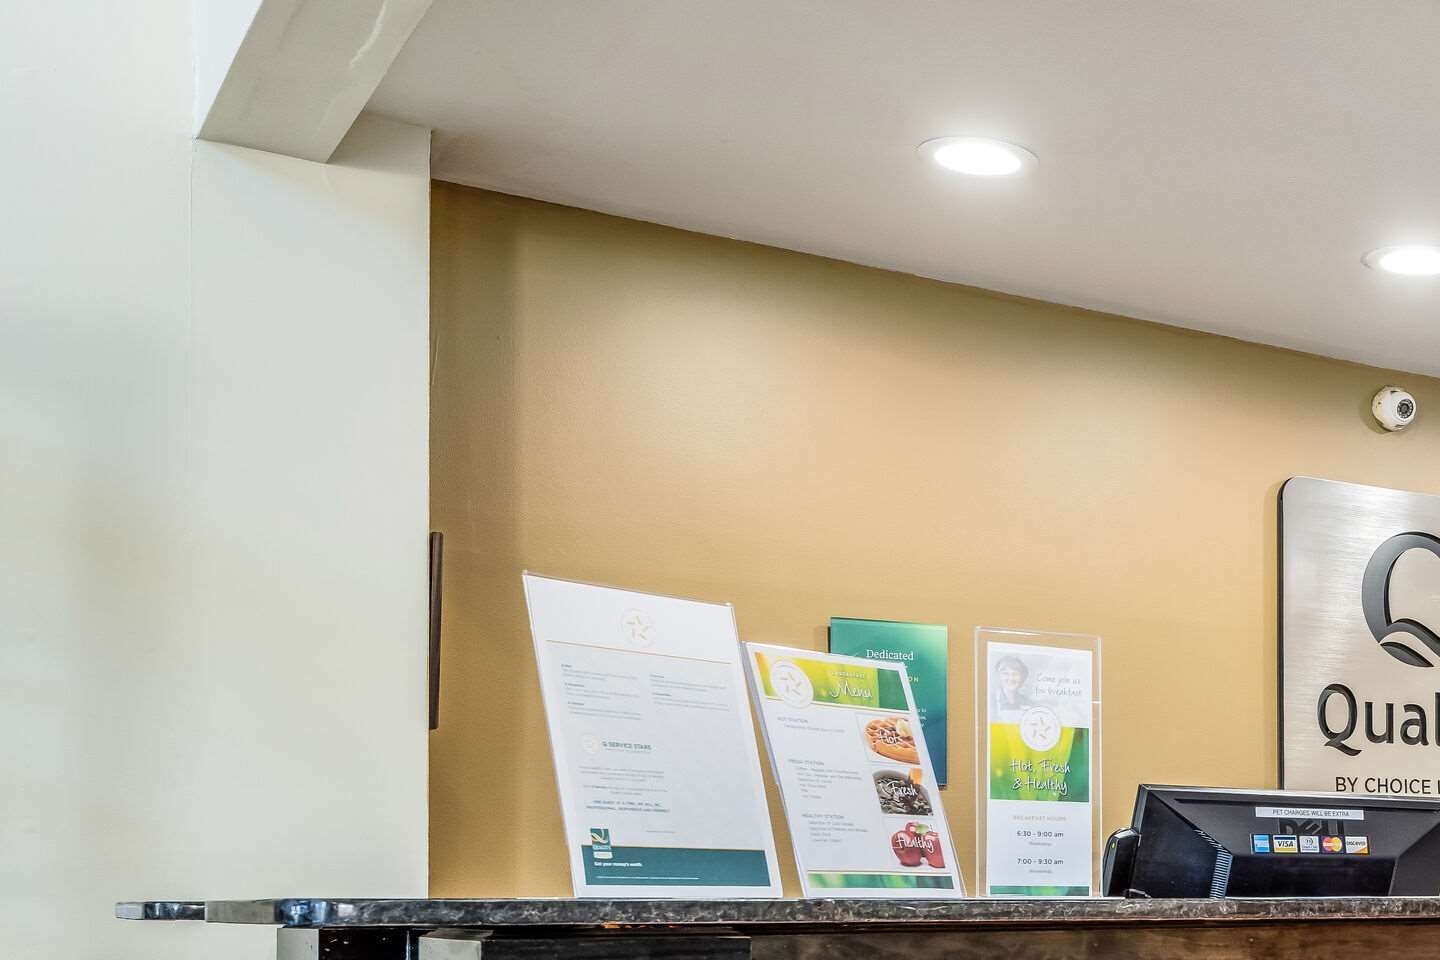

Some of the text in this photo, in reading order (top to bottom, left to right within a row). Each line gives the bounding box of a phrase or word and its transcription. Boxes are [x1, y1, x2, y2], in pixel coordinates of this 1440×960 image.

[866, 649, 914, 661] Dedicated
[1038, 759, 1071, 774] Fresh
[1024, 776, 1068, 796] Healthy
[1335, 776, 1358, 792] BY
[1364, 777, 1431, 795] CHOICE
[895, 835, 934, 854] Healthy
[1277, 840, 1294, 848] VISA
